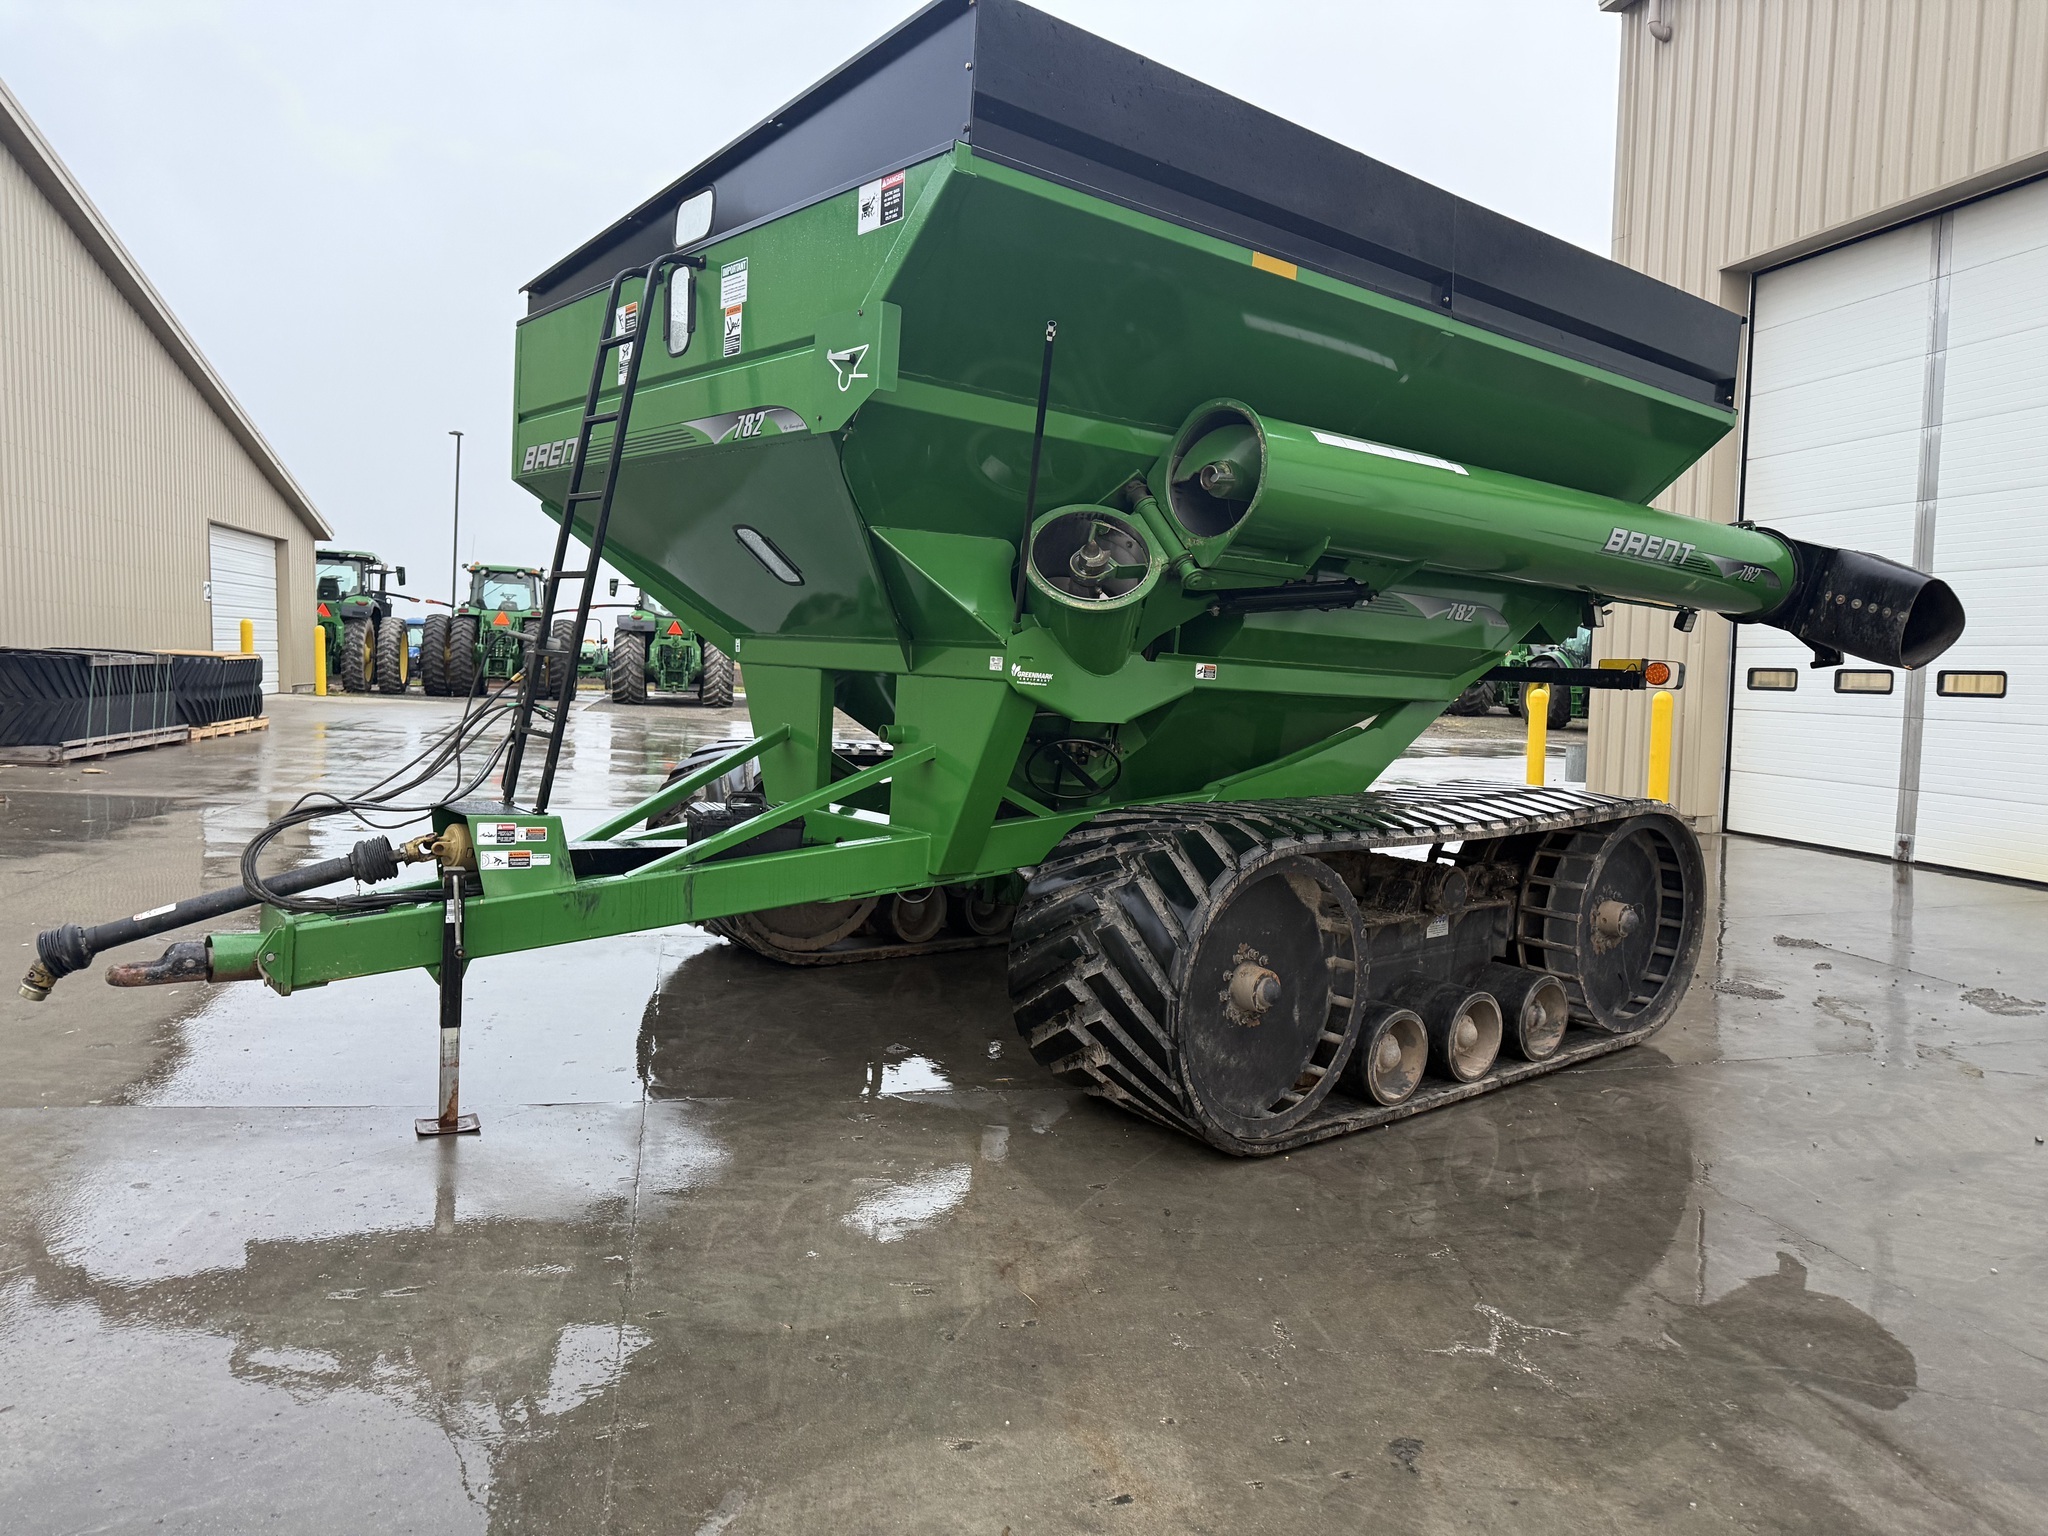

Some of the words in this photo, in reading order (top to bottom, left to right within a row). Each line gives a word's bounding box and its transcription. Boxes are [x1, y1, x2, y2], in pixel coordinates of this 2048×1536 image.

[733, 411, 765, 440] 782
[521, 432, 593, 472] BREN
[1603, 527, 1696, 565] BRENT
[1738, 565, 1761, 583] 782
[1447, 603, 1477, 621] 782
[1017, 671, 1053, 679] GREENMARK
